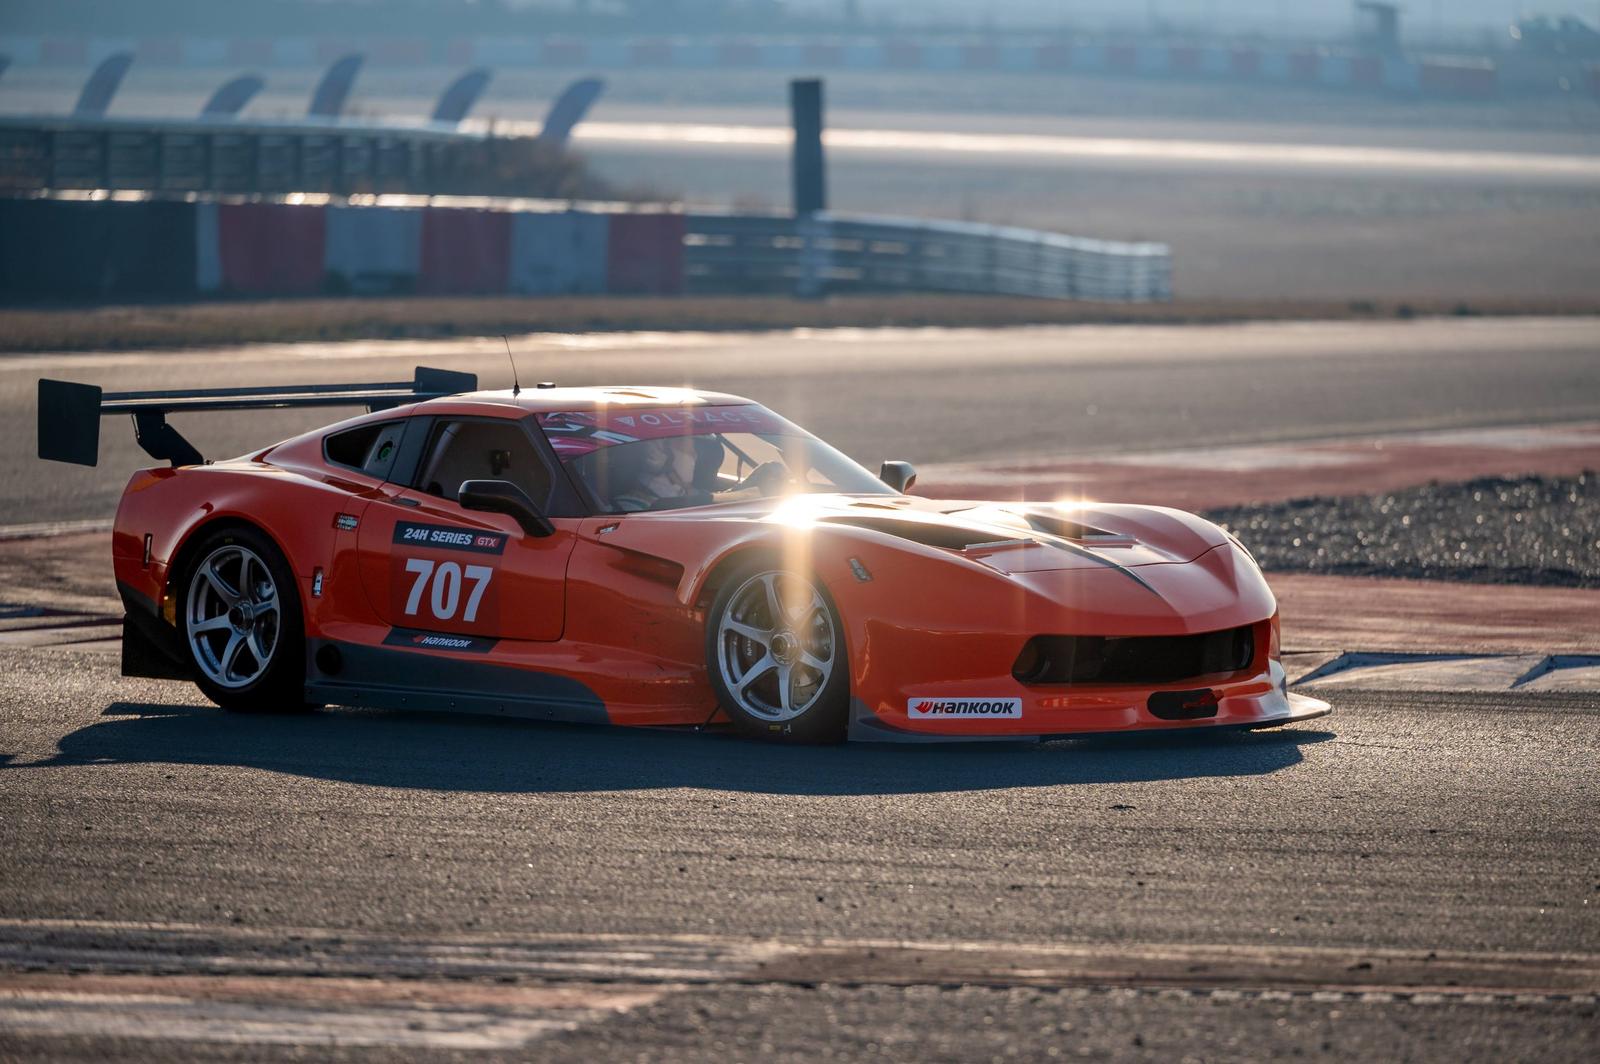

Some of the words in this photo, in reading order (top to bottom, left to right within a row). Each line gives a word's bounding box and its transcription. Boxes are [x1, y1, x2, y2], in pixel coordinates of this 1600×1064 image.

[403, 527, 429, 541] 24H
[430, 530, 473, 545] SERIES
[477, 537, 497, 547] GTX
[404, 558, 494, 623] 707
